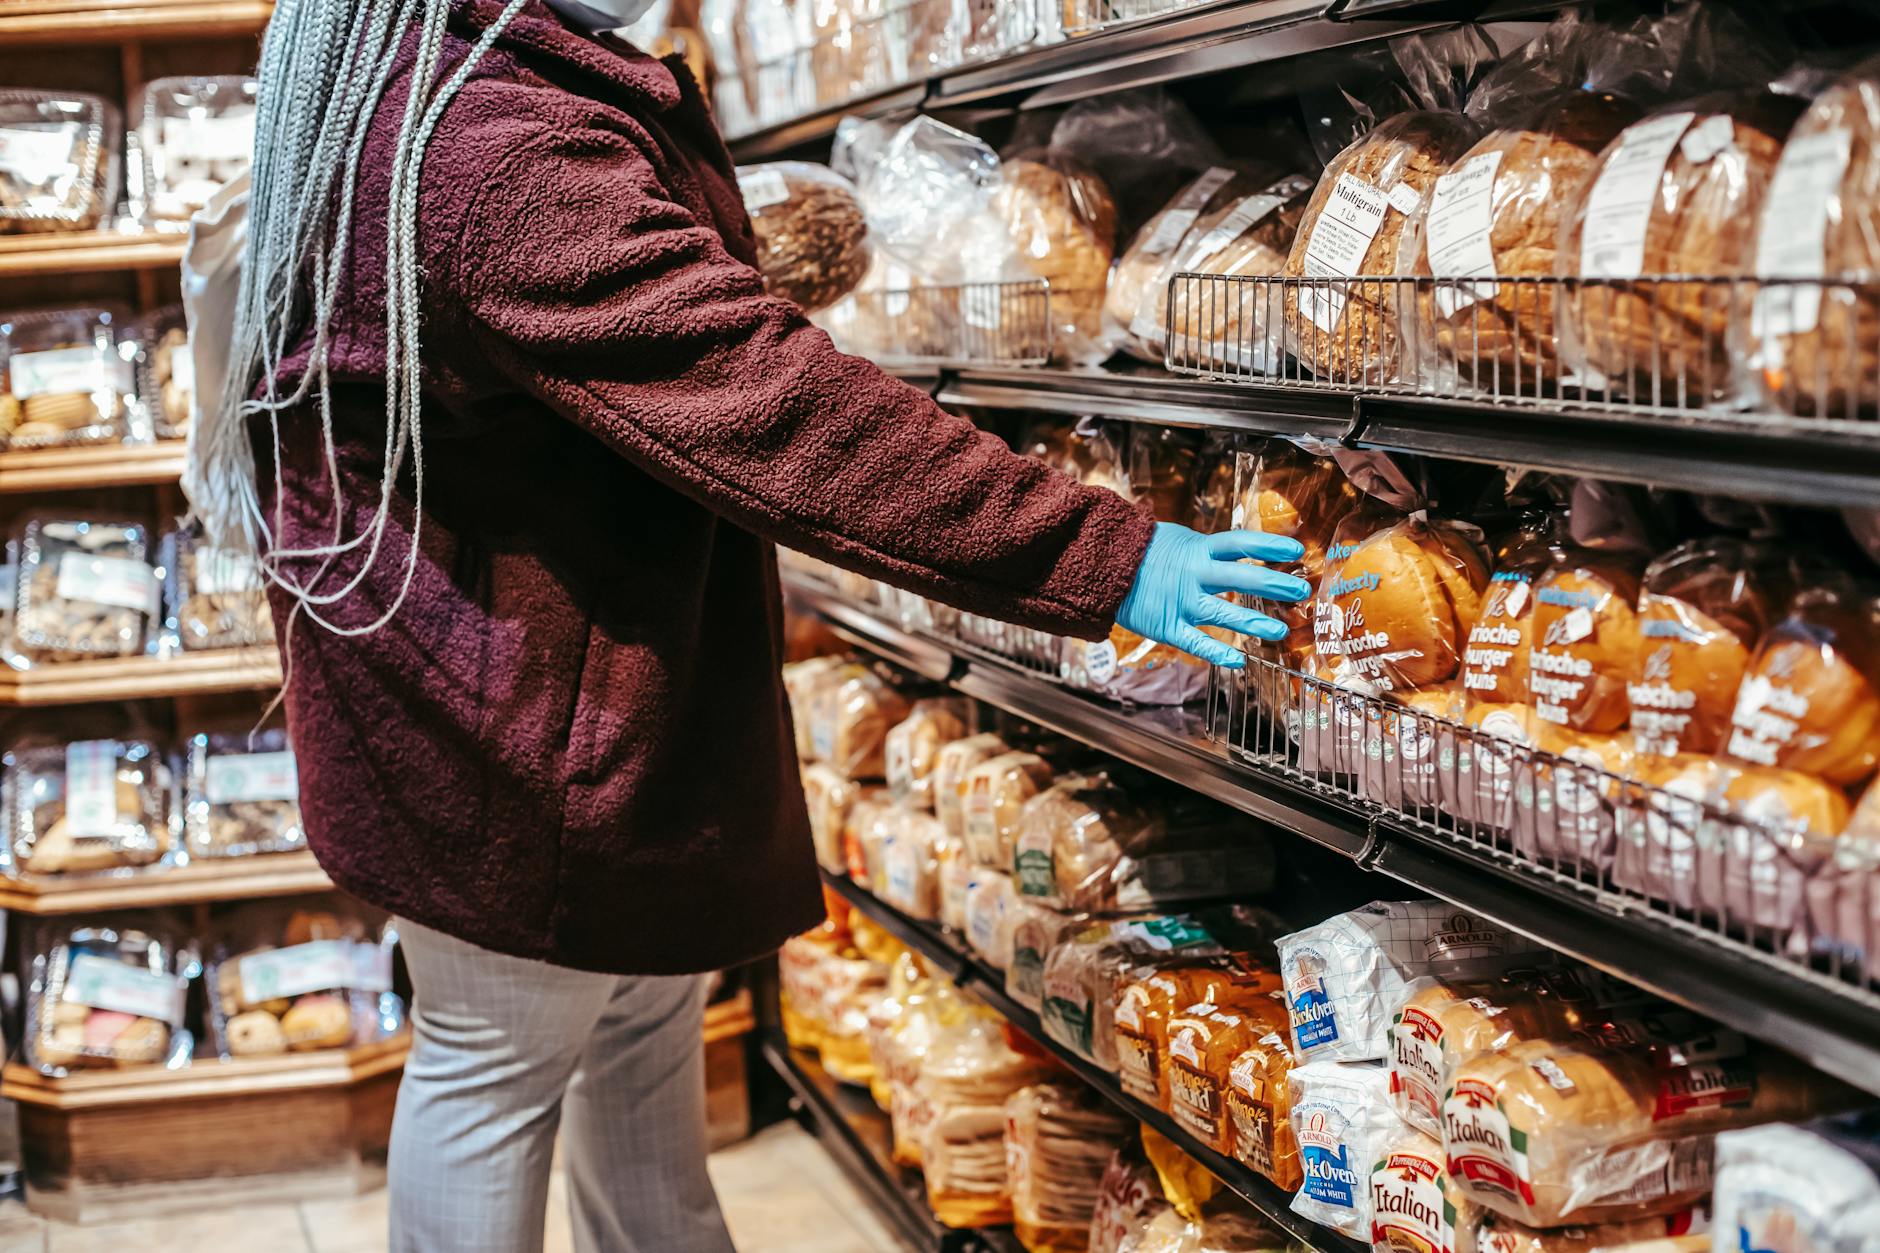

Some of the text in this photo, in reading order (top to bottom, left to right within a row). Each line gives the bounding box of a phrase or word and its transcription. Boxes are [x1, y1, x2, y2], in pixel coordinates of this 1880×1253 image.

[1336, 182, 1383, 218] Multigrain
[1345, 174, 1355, 186] ALL
[1355, 180, 1383, 200] NATURAL
[1344, 597, 1365, 631] the
[1351, 655, 1386, 677] urge
[1464, 666, 1497, 690] buns
[1440, 933, 1493, 946] ARNOLD
[1289, 1000, 1336, 1028] BckOven
[1302, 1131, 1332, 1145] ARNOLD
[1446, 1112, 1507, 1153] Italian
[1327, 1188, 1347, 1200] WHITE
[1374, 1183, 1439, 1231] Italian
